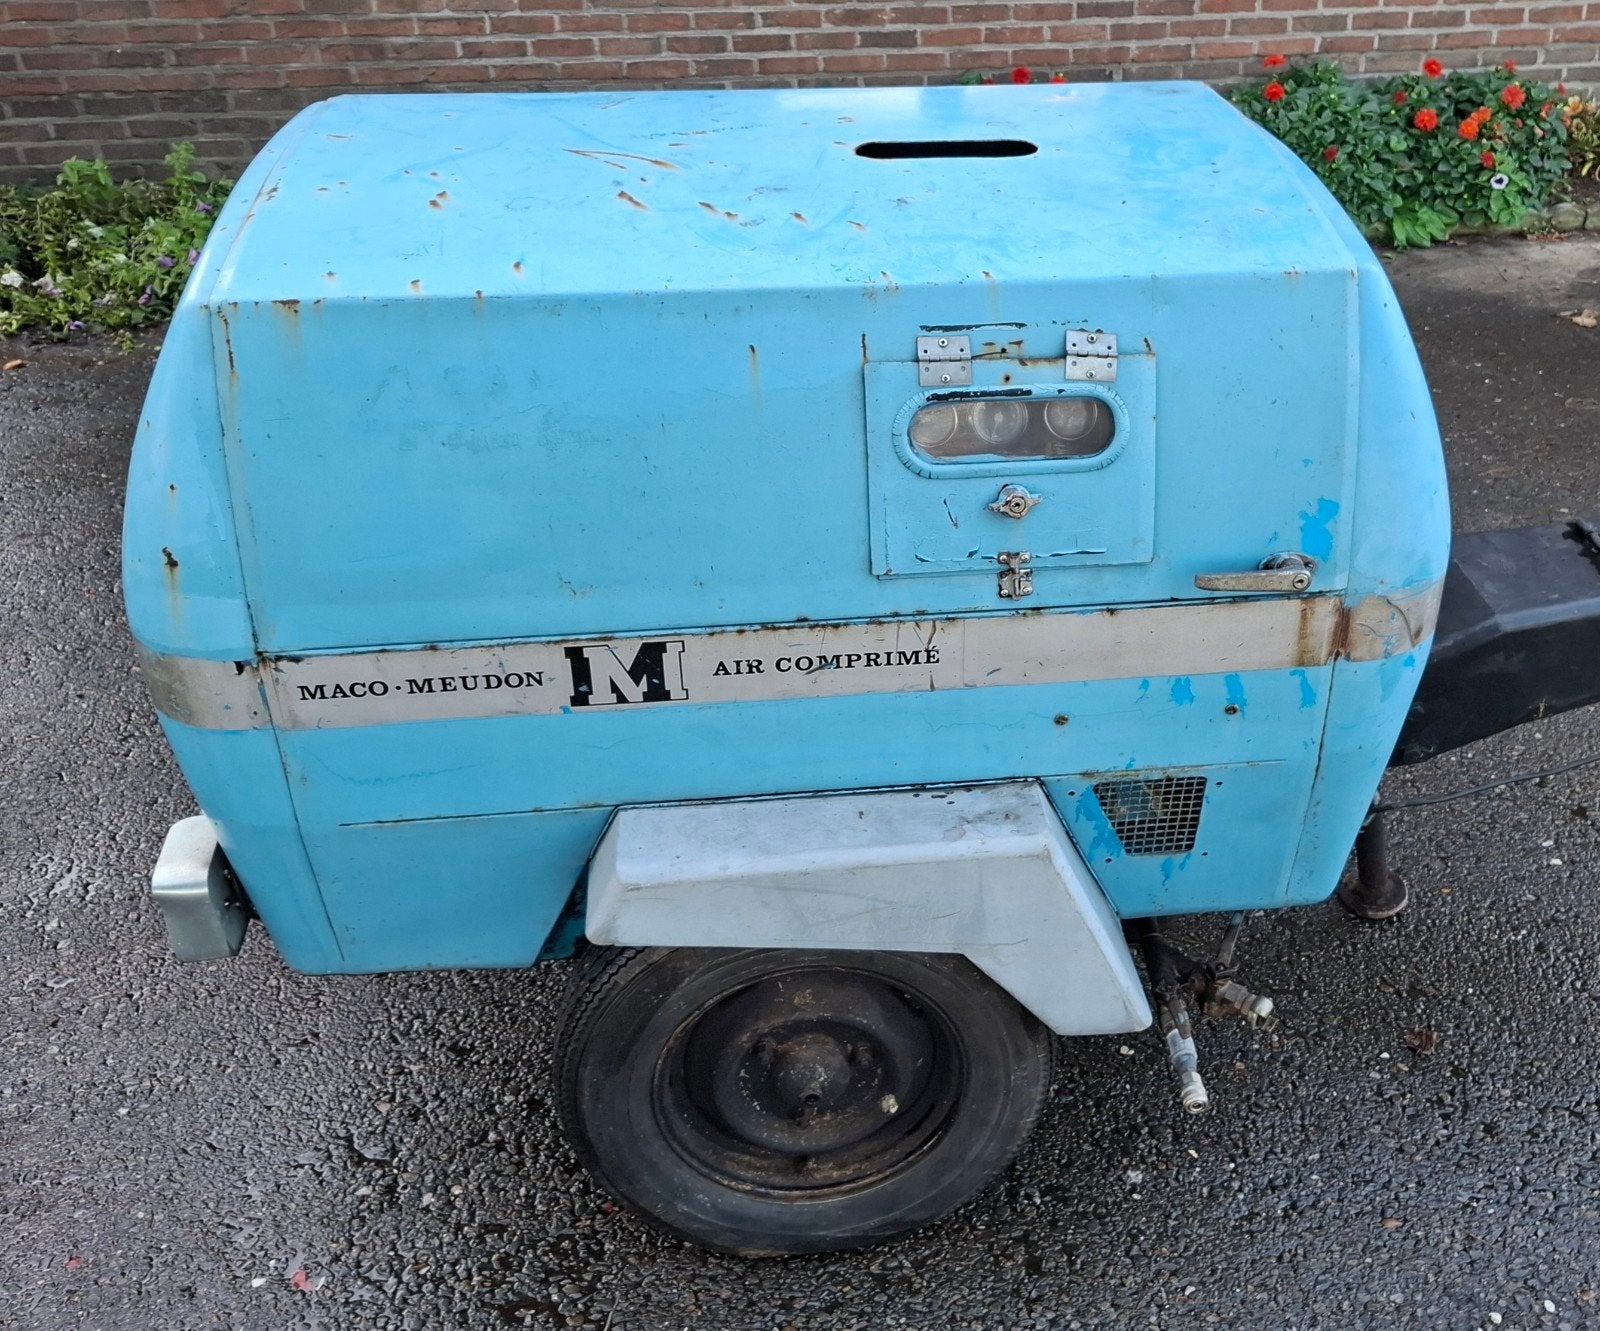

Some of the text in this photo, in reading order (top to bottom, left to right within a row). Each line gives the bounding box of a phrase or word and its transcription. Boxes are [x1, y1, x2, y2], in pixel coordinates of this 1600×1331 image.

[563, 640, 690, 708] M
[712, 658, 766, 677] AIR
[774, 645, 941, 674] COMPRIMÉ
